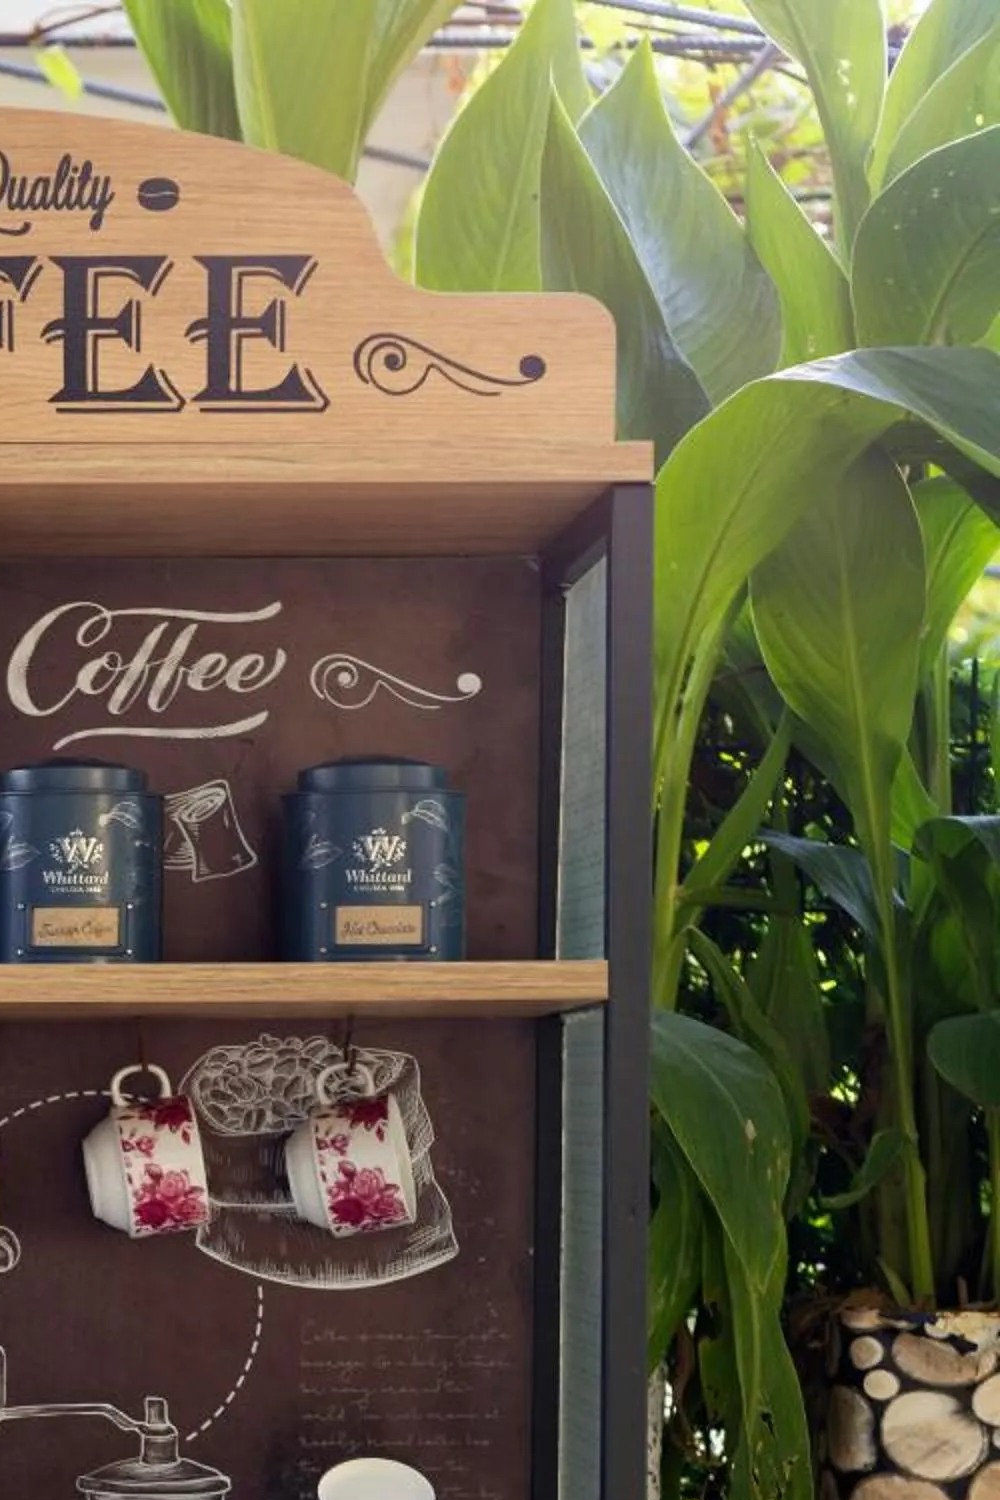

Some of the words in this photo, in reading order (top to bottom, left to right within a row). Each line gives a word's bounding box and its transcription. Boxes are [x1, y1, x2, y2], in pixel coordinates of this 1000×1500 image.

[6, 600, 288, 717] Coffee
[42, 871, 110, 886] Whittard
[344, 868, 412, 884] Whittard
